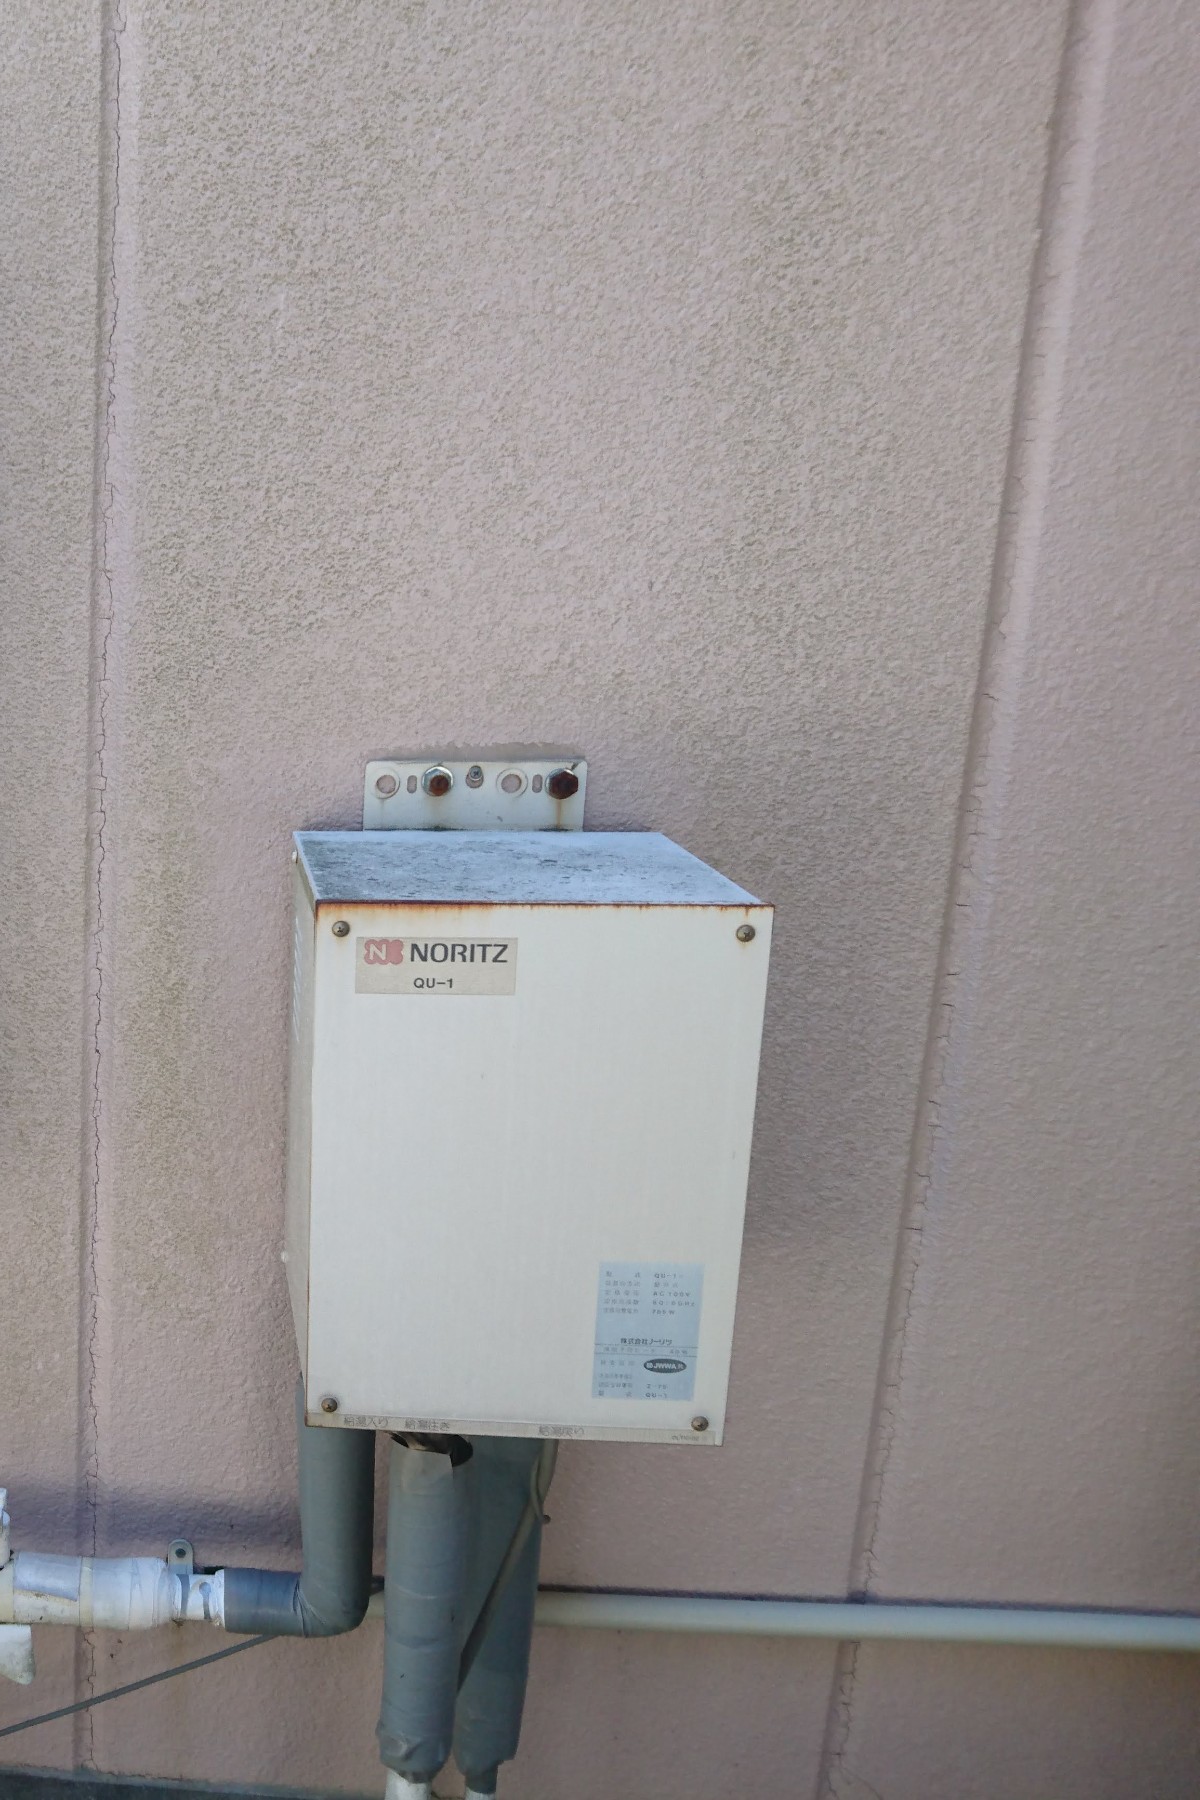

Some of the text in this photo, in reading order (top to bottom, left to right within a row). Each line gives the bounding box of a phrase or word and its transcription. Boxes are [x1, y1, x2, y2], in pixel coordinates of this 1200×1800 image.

[410, 942, 509, 963] NORITZ
[413, 977, 454, 989] QU-1
[620, 1338, 673, 1346] 株式会社ノーリツ
